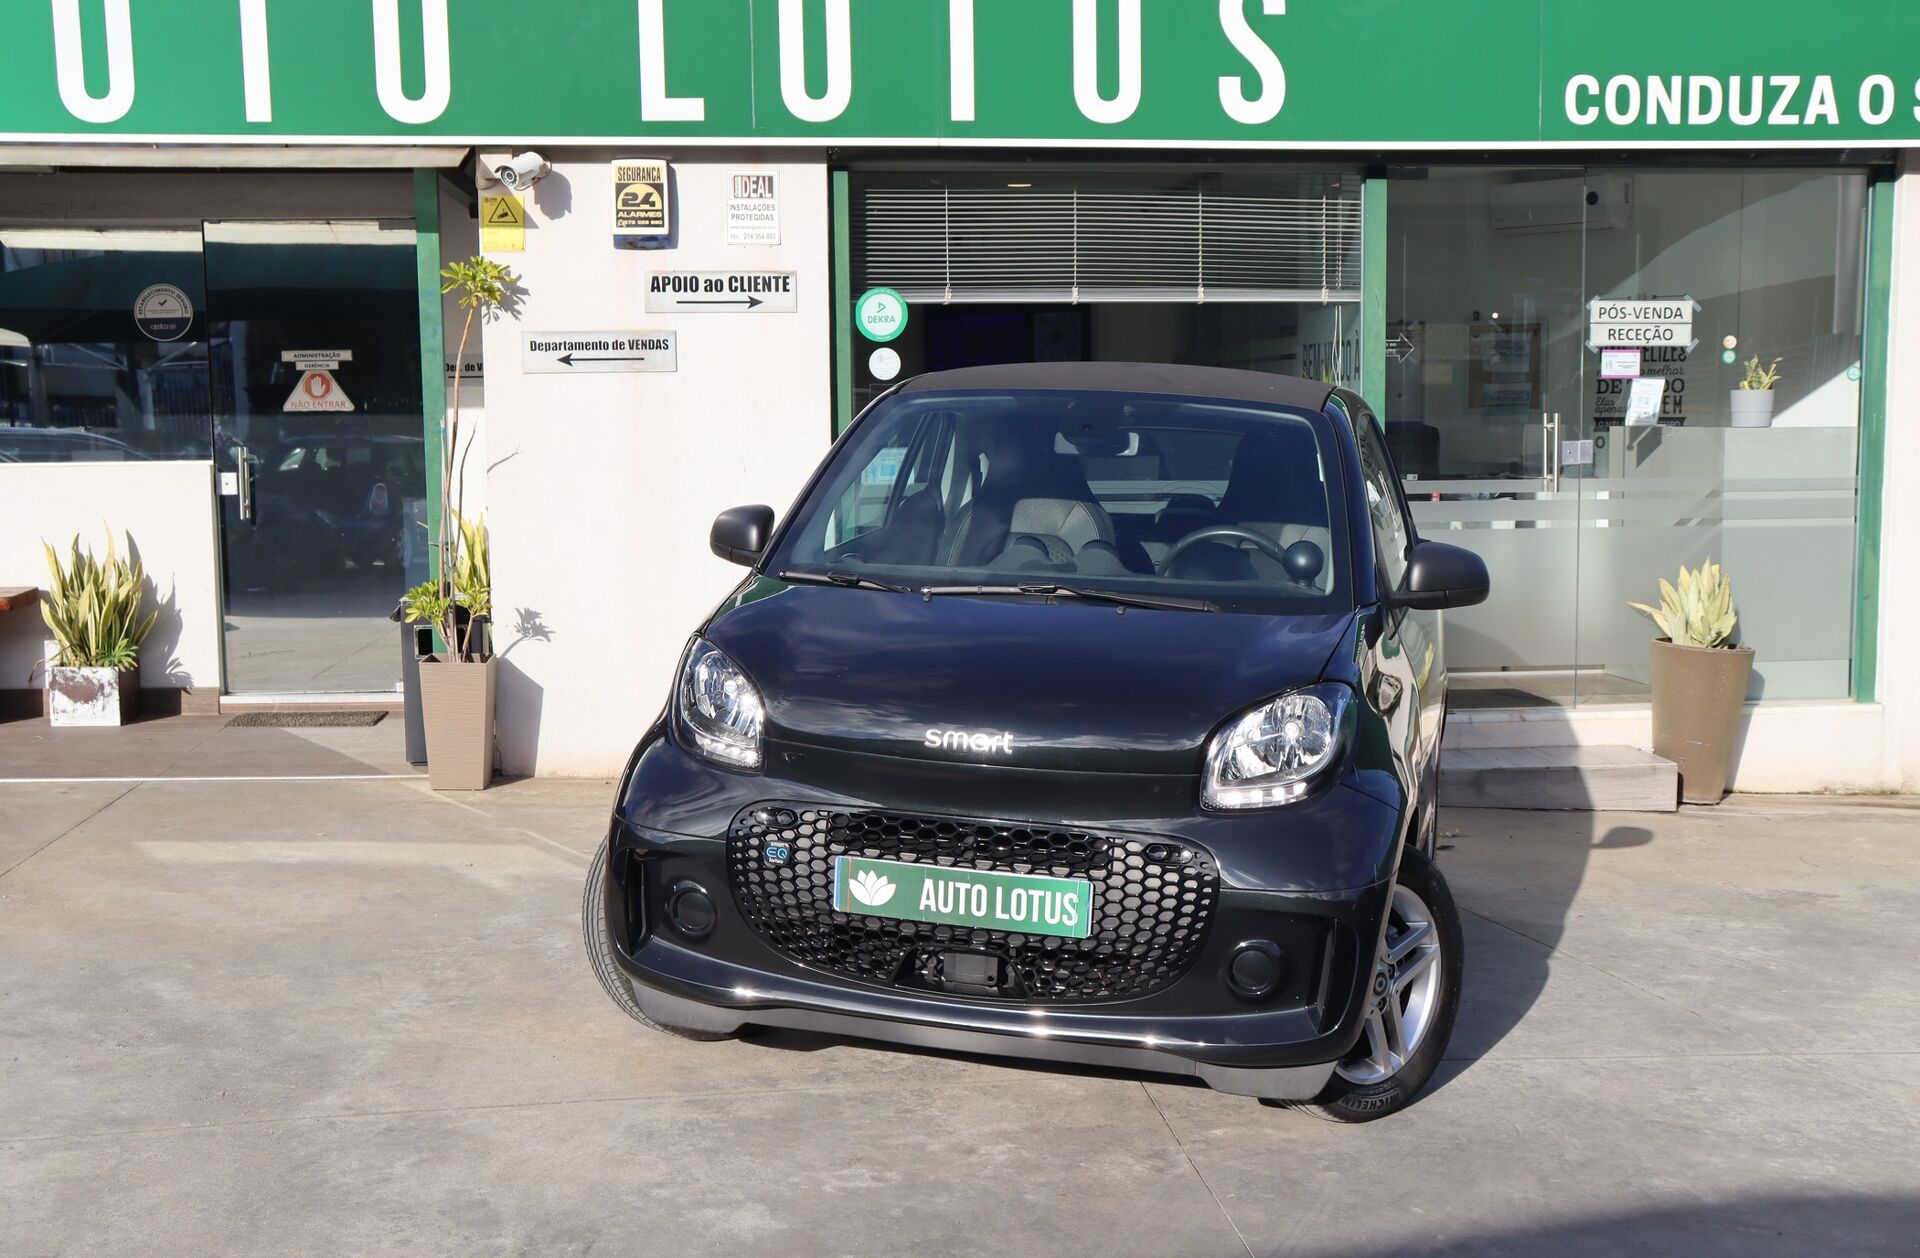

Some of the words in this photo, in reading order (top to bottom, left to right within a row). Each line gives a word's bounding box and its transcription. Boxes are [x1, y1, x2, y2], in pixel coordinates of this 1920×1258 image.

[1564, 74, 1840, 125] CONDUZA
[1858, 74, 1895, 125] O
[734, 175, 773, 198] IDEAL
[622, 192, 656, 207] 24
[729, 203, 776, 212] INSTALAÇÕES
[731, 213, 774, 221] PROTEGIDAS
[650, 275, 699, 293] APOIO
[703, 278, 724, 293] ao
[728, 275, 790, 293] CLIENTE
[1598, 303, 1684, 320] PÓS-VENDA
[867, 315, 896, 324] DEKRA
[1608, 325, 1674, 344] RECEÇÃO
[530, 340, 609, 353] Departamento
[611, 339, 626, 351] de
[628, 339, 669, 350] VENDAS
[464, 363, 476, 372] de
[1596, 379, 1623, 395] DE
[291, 400, 309, 409] NÃO
[313, 400, 346, 409] ENTRAR
[924, 727, 1014, 755] smart
[766, 847, 787, 859] EQ
[919, 878, 986, 918] AUTO
[995, 887, 1080, 927] LOTUS
